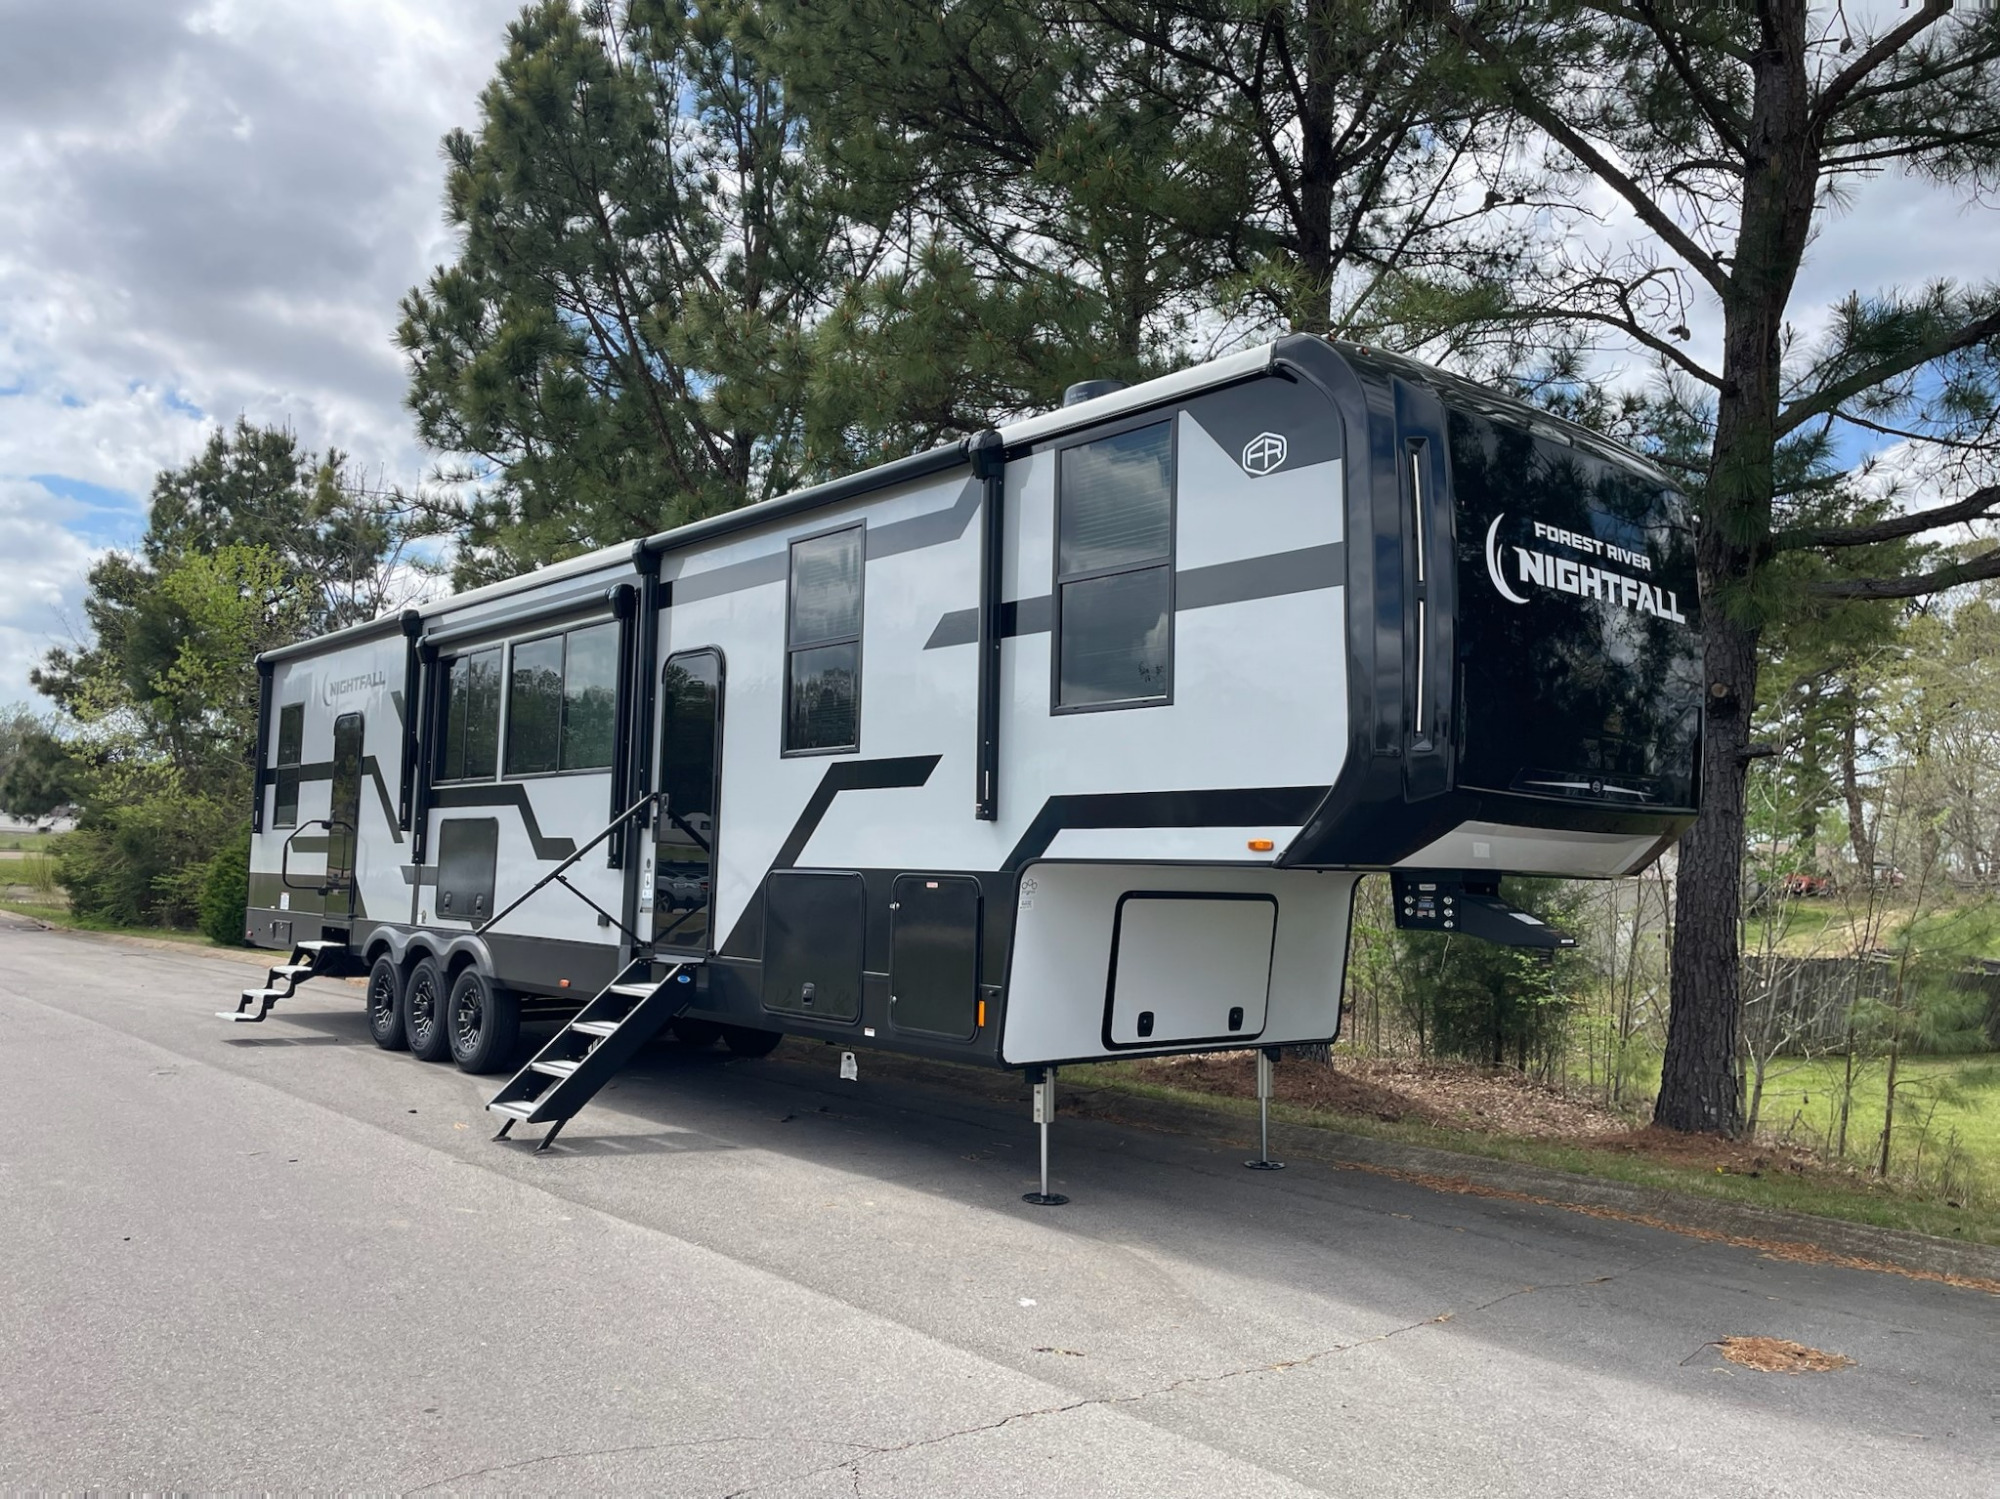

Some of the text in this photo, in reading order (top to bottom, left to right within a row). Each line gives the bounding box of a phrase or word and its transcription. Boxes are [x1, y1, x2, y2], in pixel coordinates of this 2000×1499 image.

[1534, 521, 1651, 572] FOREST RIVER
[1512, 545, 1686, 625] NIGHTFALL
[329, 671, 386, 697] NIGHTFALL
